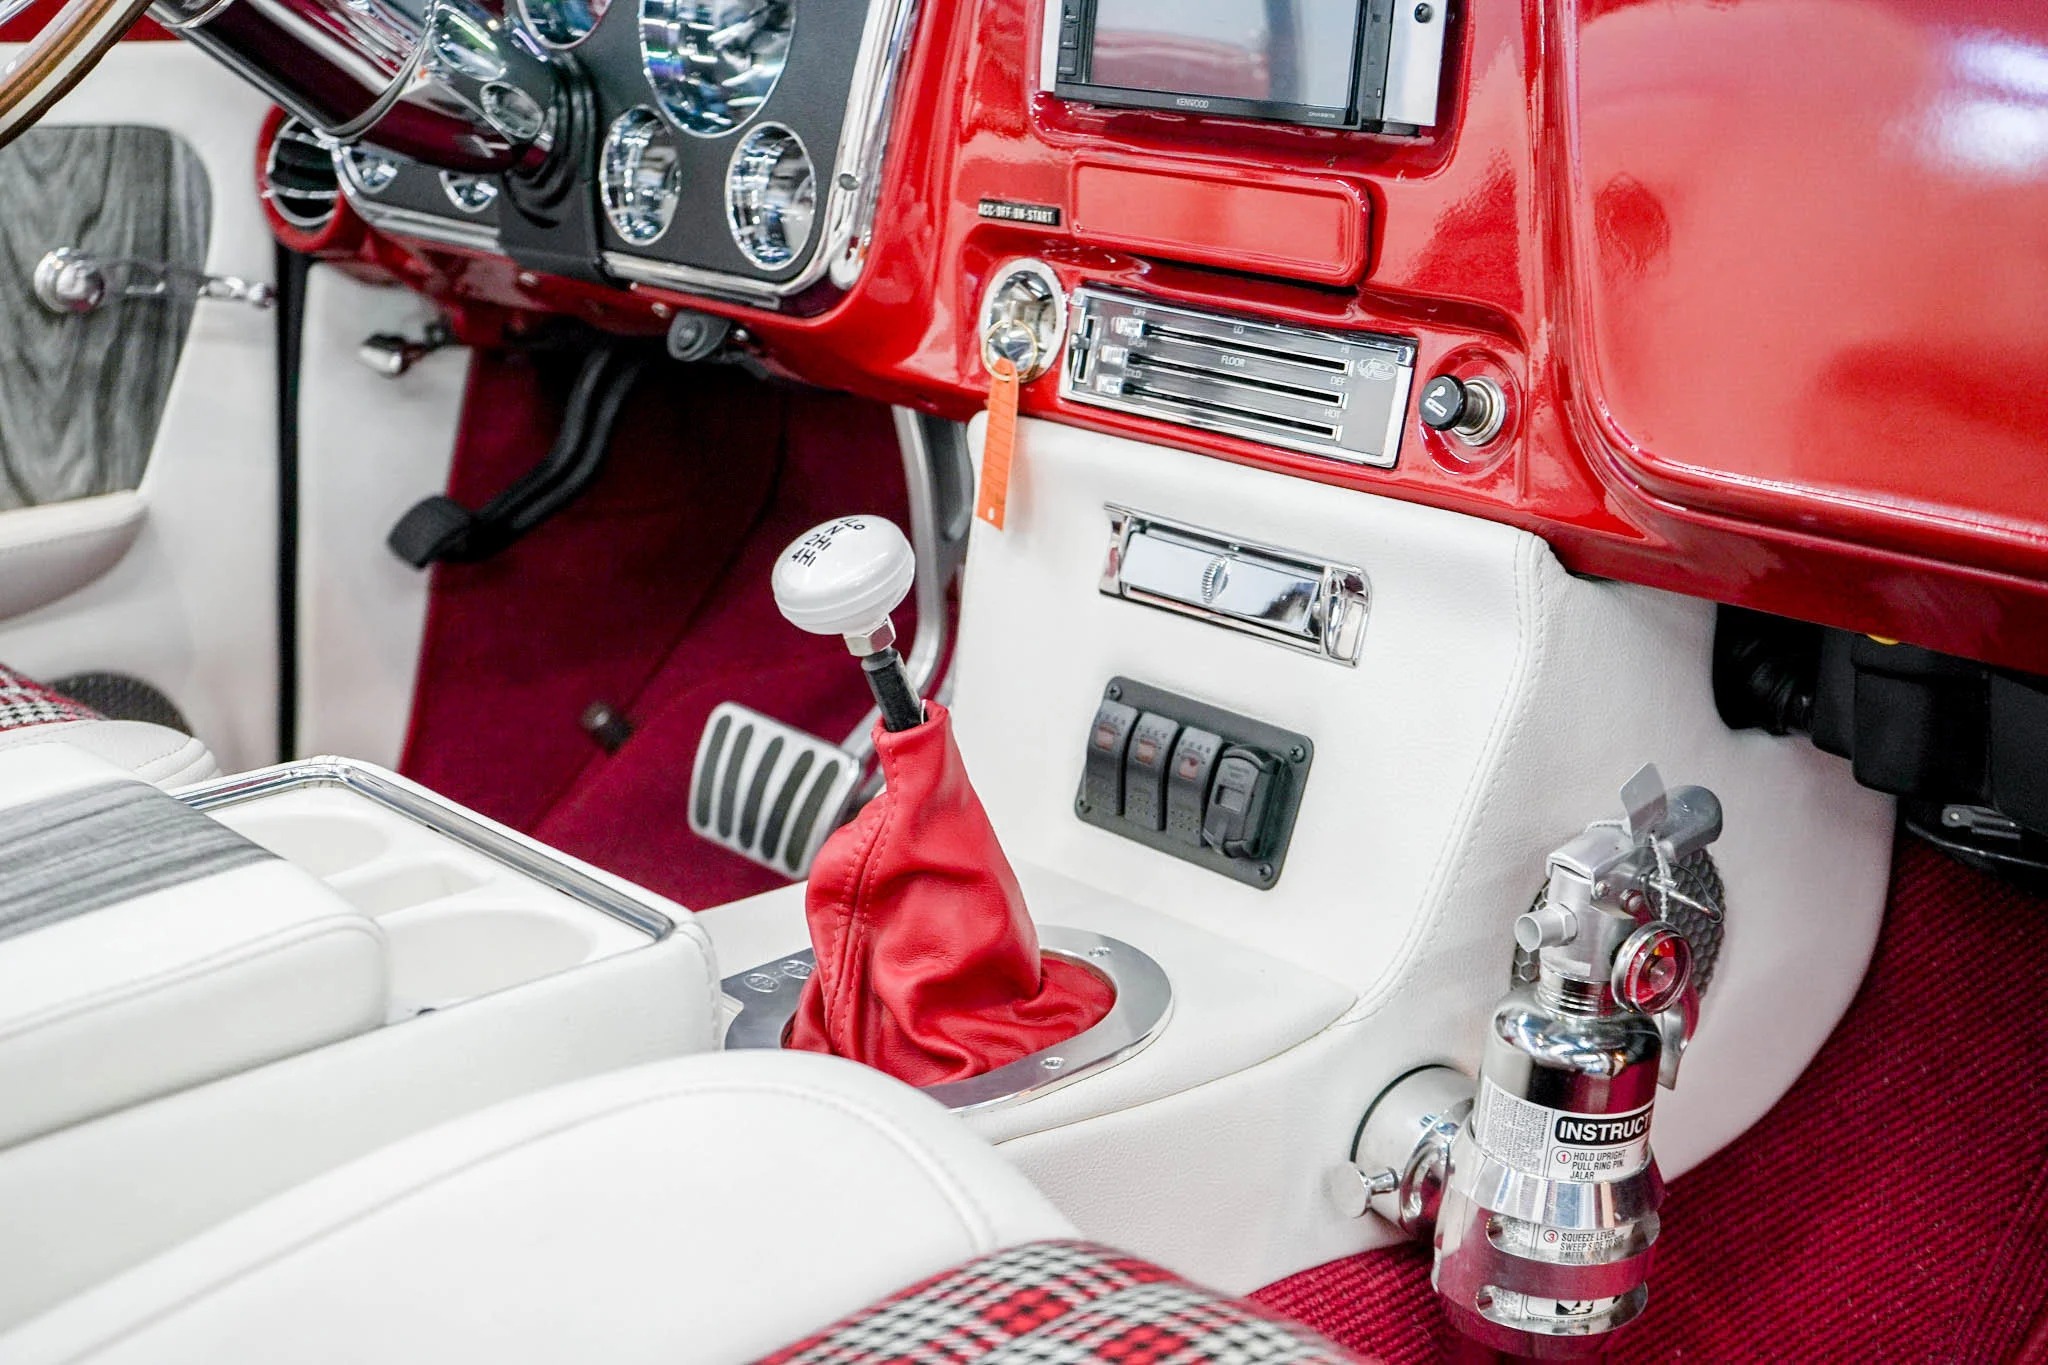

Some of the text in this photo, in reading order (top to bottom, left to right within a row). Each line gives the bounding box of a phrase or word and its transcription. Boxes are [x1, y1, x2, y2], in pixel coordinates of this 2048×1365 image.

[1176, 98, 1209, 109] KENWOOD
[1233, 326, 1244, 334] LO
[1221, 355, 1246, 367] FLOOR
[1330, 376, 1346, 386] DEF
[1324, 408, 1341, 419] HOT
[825, 525, 845, 536] N
[1561, 1153, 1567, 1162] 1
[1573, 1151, 1595, 1161] HOLD
[1571, 1162, 1592, 1171] PULL
[1594, 1161, 1612, 1171] RING
[1570, 1171, 1595, 1180] JALAR
[1548, 1233, 1555, 1242] 3
[1561, 1231, 1594, 1242] SQUEEZE
[1560, 1242, 1587, 1251] SWEEP
